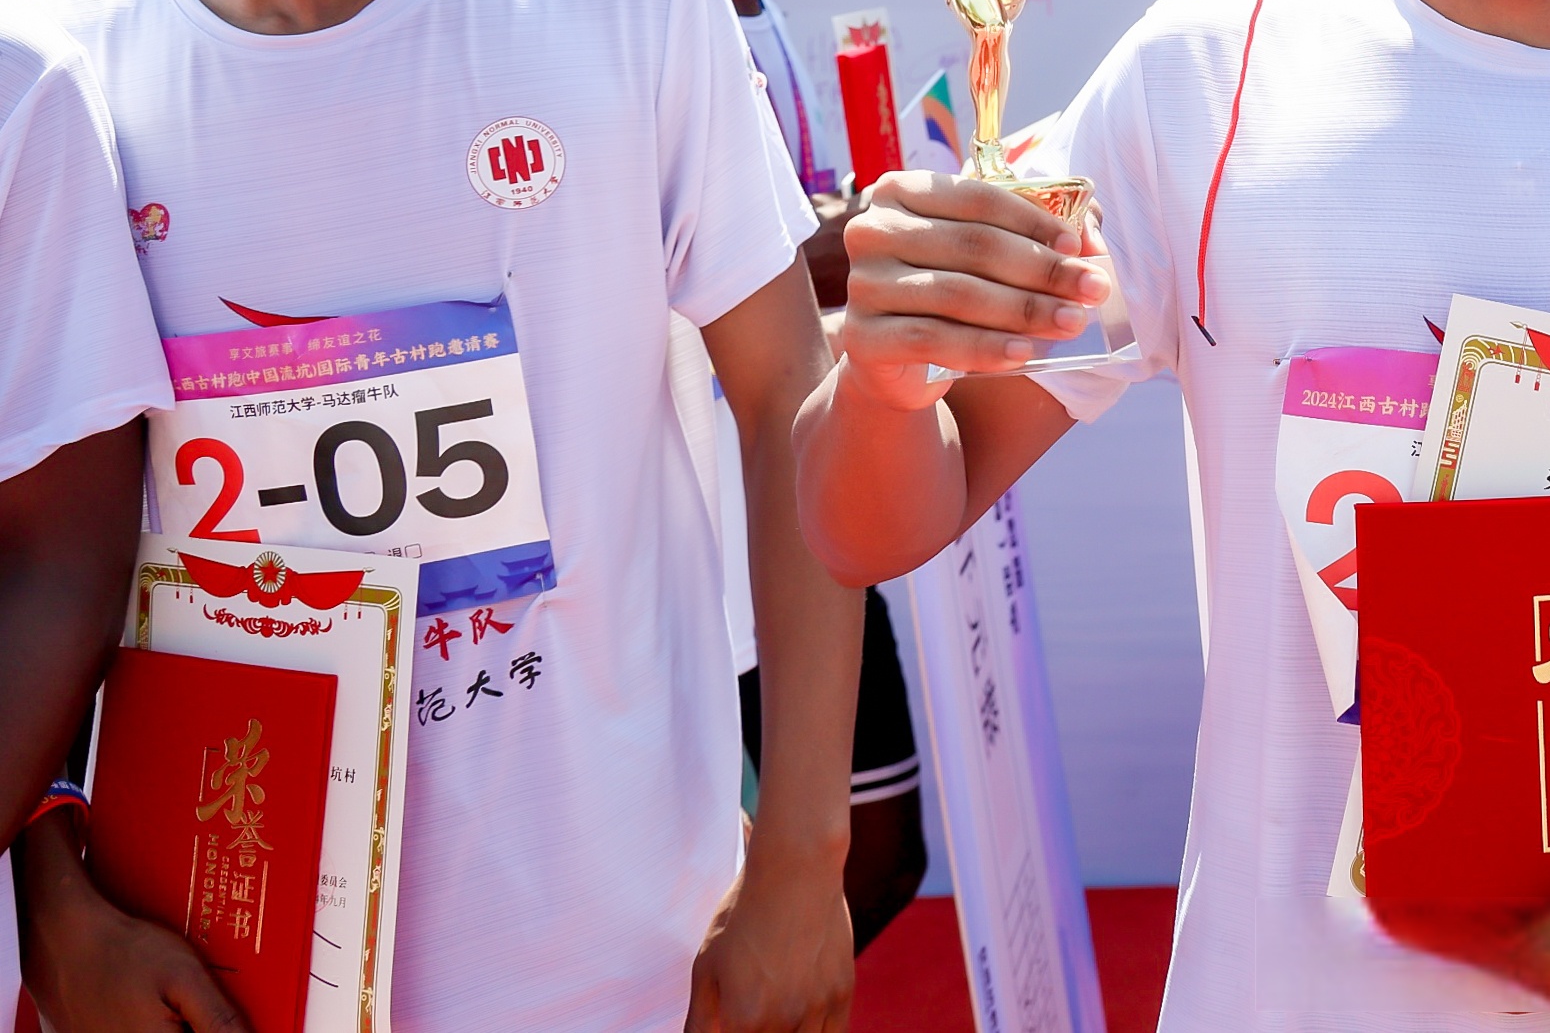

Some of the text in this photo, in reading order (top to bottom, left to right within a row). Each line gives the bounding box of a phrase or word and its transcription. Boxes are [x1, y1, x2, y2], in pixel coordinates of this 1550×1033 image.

[483, 119, 520, 137] NORMAL
[525, 120, 563, 158] UNIVERSITY
[511, 185, 534, 195] 1940
[174, 398, 510, 544] 2-05
[198, 833, 220, 945] HONORARY
[215, 855, 230, 923] CREDENTIAL
